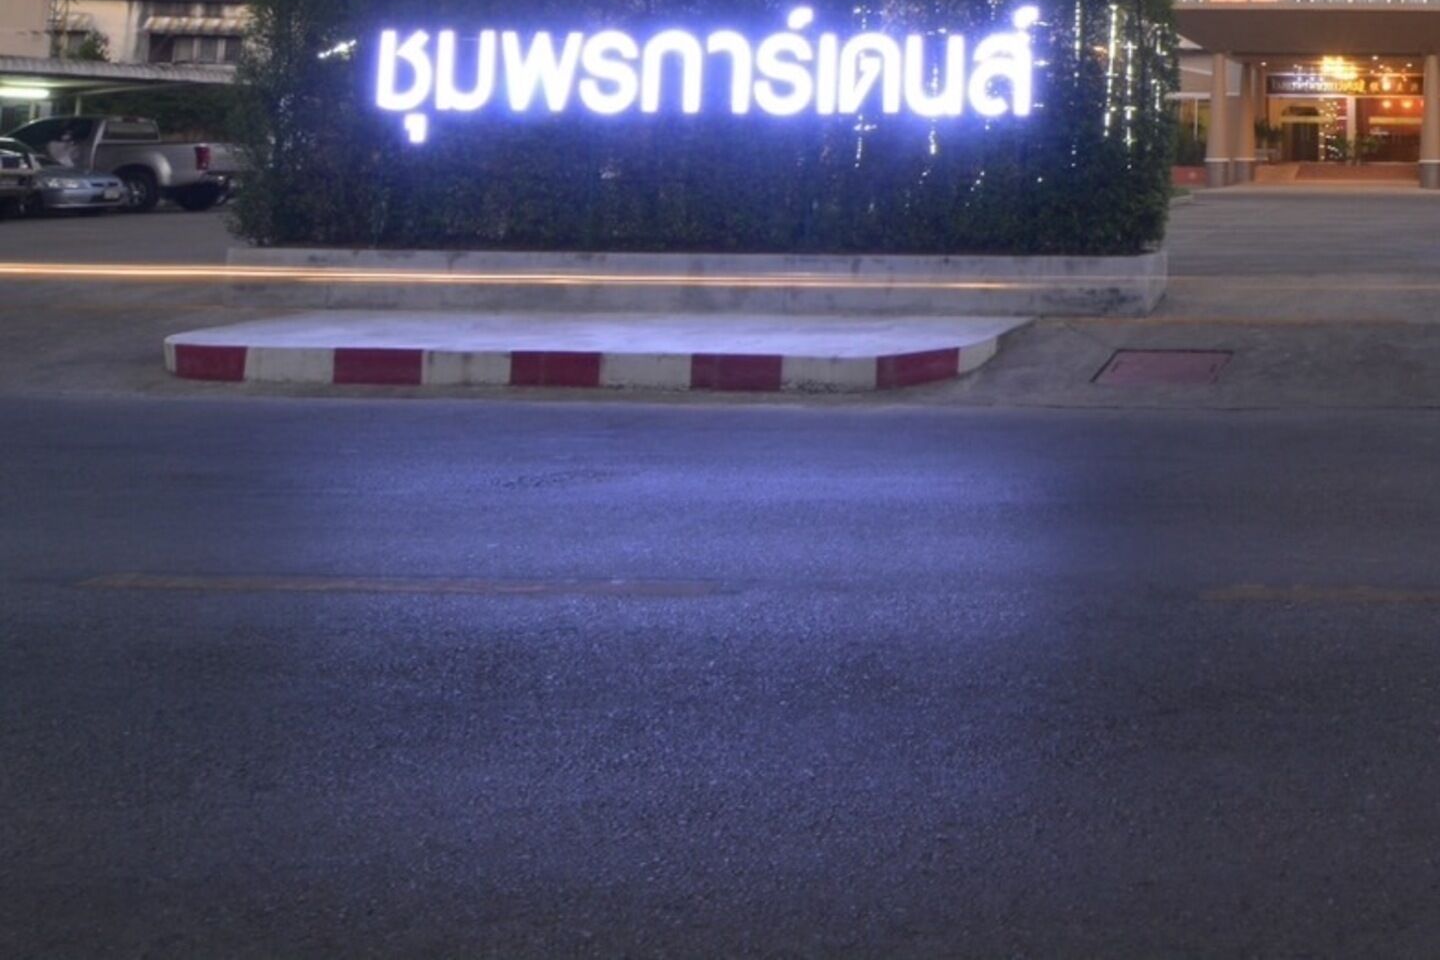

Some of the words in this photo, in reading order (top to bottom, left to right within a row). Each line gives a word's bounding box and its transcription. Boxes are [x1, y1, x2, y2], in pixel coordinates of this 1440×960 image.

[376, 6, 1040, 143] ชุมพรการ์เดนส์
